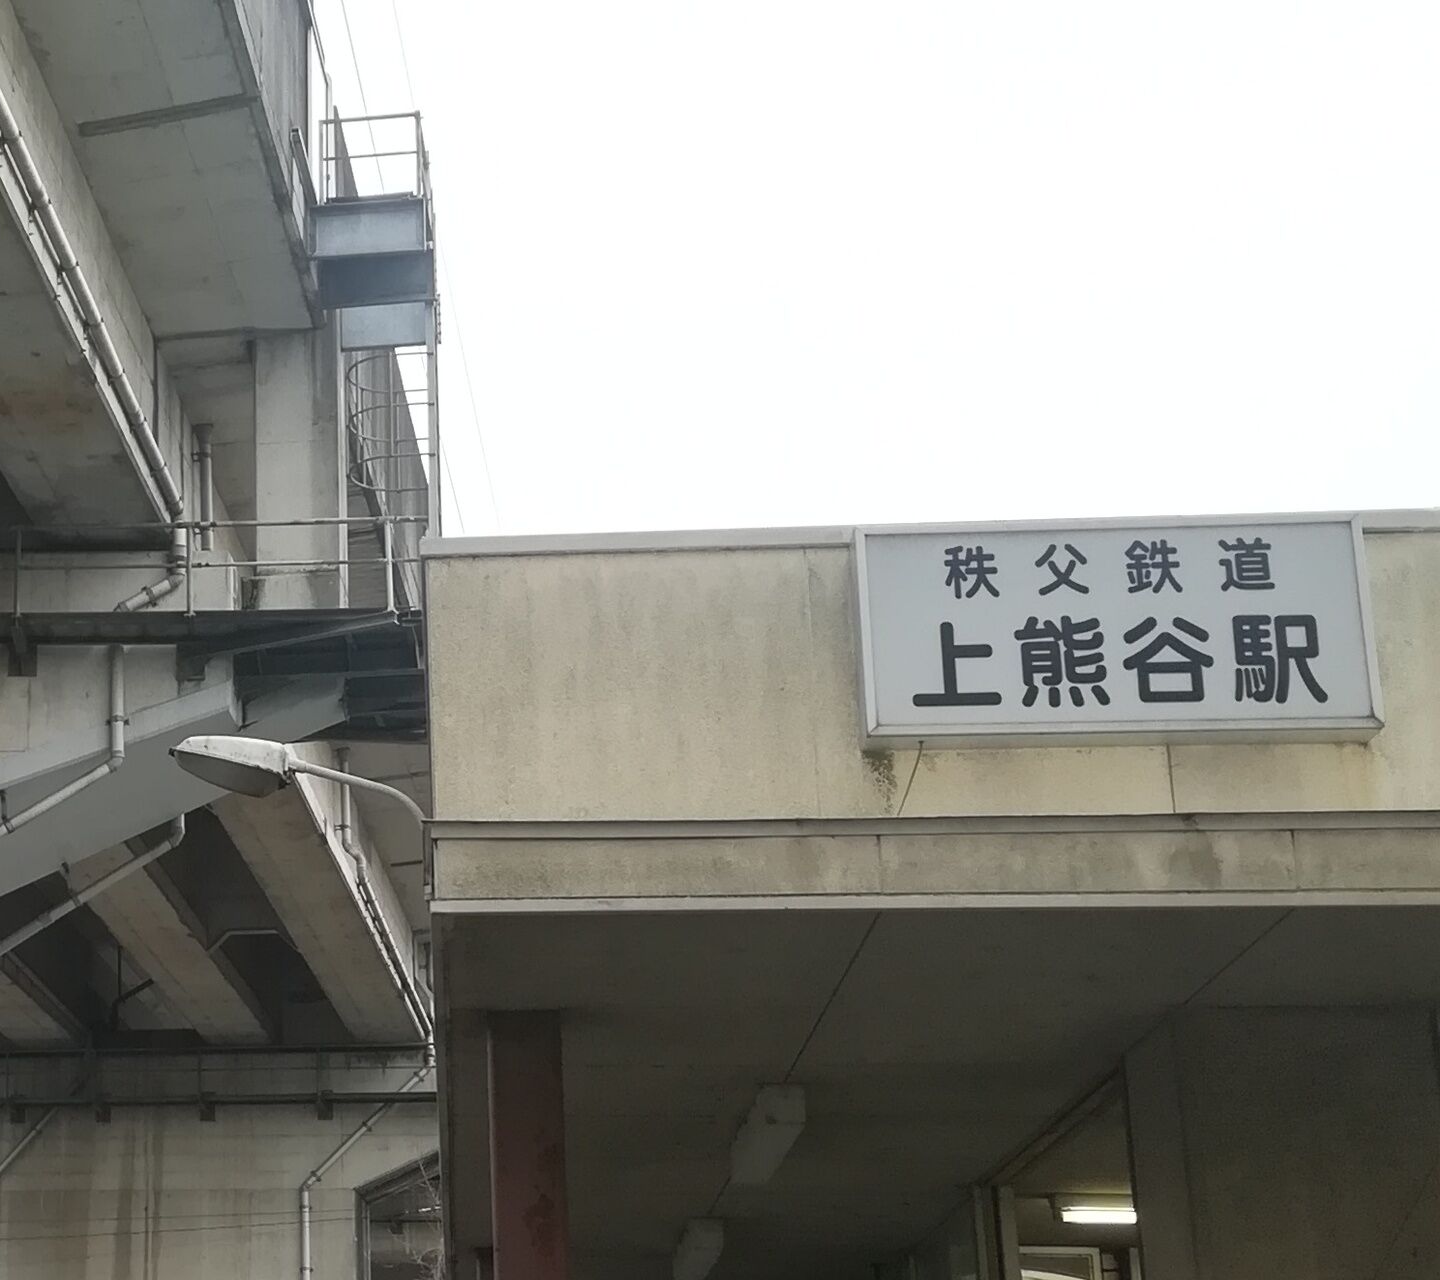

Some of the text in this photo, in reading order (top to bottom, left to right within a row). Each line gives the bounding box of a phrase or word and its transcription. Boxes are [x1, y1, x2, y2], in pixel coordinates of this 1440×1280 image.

[944, 537, 1276, 599] 秩父鉄道
[912, 614, 1329, 708] 上熊谷駅
